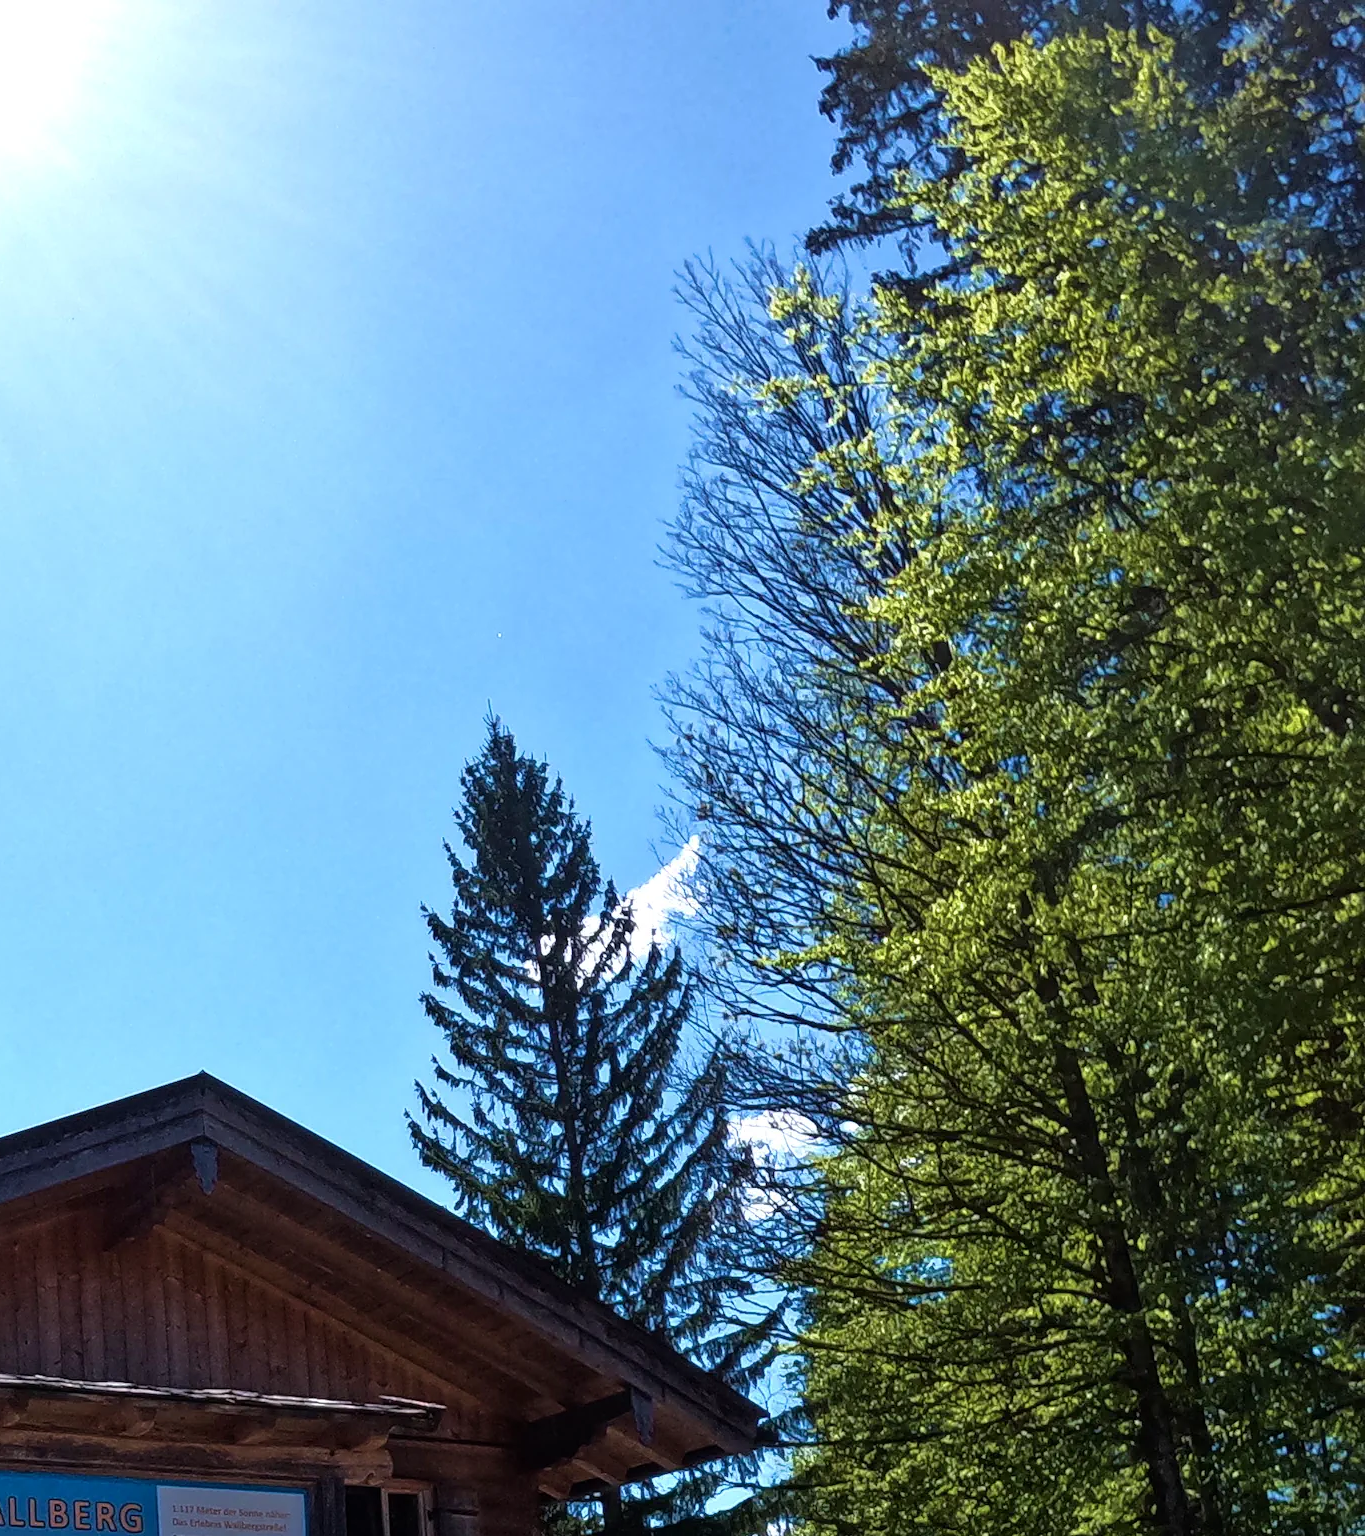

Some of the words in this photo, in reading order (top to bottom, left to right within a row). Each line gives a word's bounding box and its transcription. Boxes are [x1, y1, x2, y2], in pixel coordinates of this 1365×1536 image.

[223, 1507, 236, 1516] der
[239, 1509, 264, 1517] Sonne
[173, 1518, 189, 1526] Das
